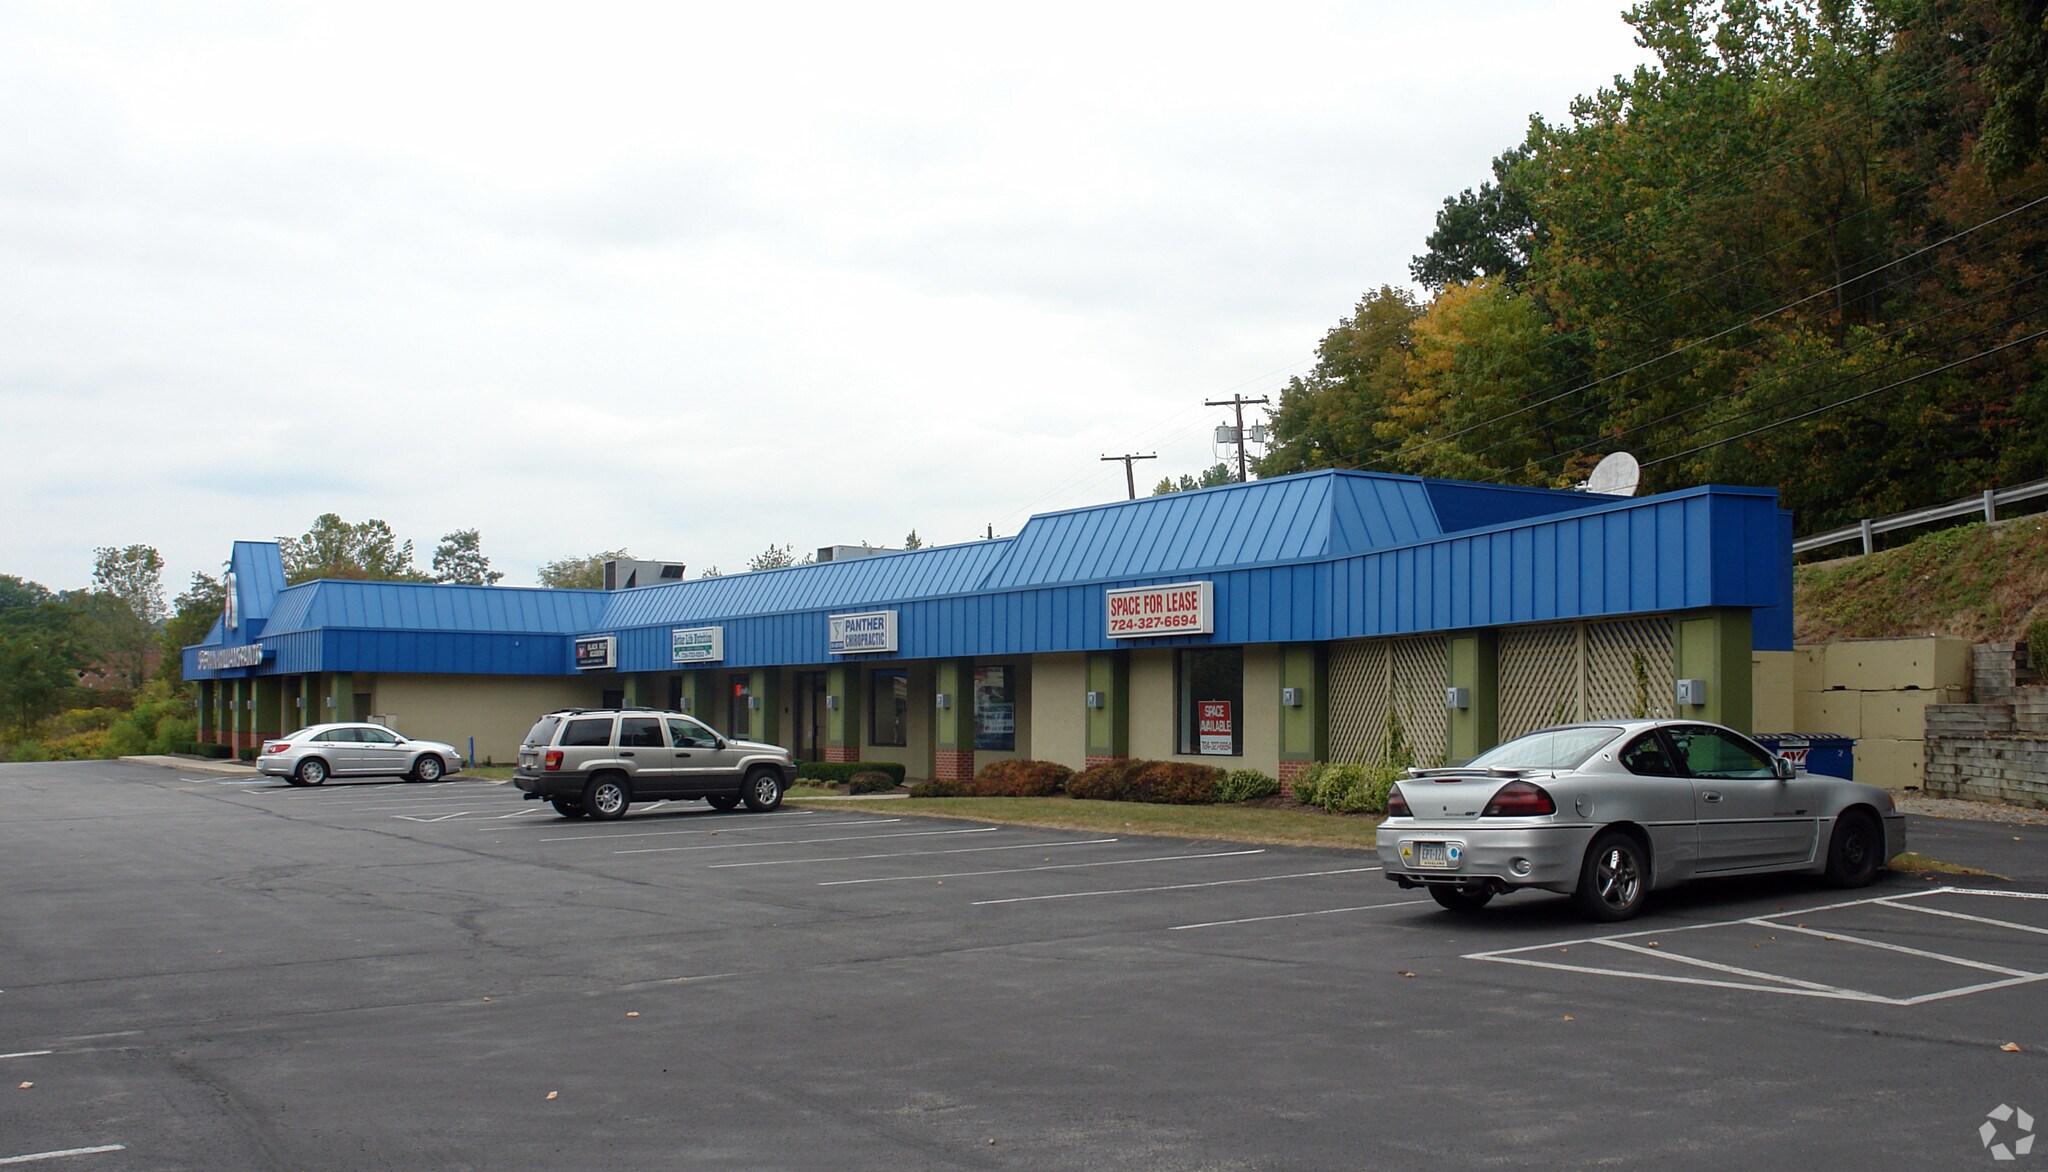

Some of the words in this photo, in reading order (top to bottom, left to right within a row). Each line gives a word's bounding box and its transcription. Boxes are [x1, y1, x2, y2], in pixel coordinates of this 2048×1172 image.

[1111, 596, 1140, 616] SPACE
[1144, 594, 1163, 614] FOR
[1166, 591, 1198, 612] LEASE
[845, 617, 884, 632] PANTHER
[1111, 614, 1198, 631] 724-327-6694
[845, 632, 885, 647] CHIROPRACTIC
[1204, 705, 1225, 717] SPACE
[1200, 720, 1231, 732] AVAILABLE
[1838, 749, 1844, 757] 2
